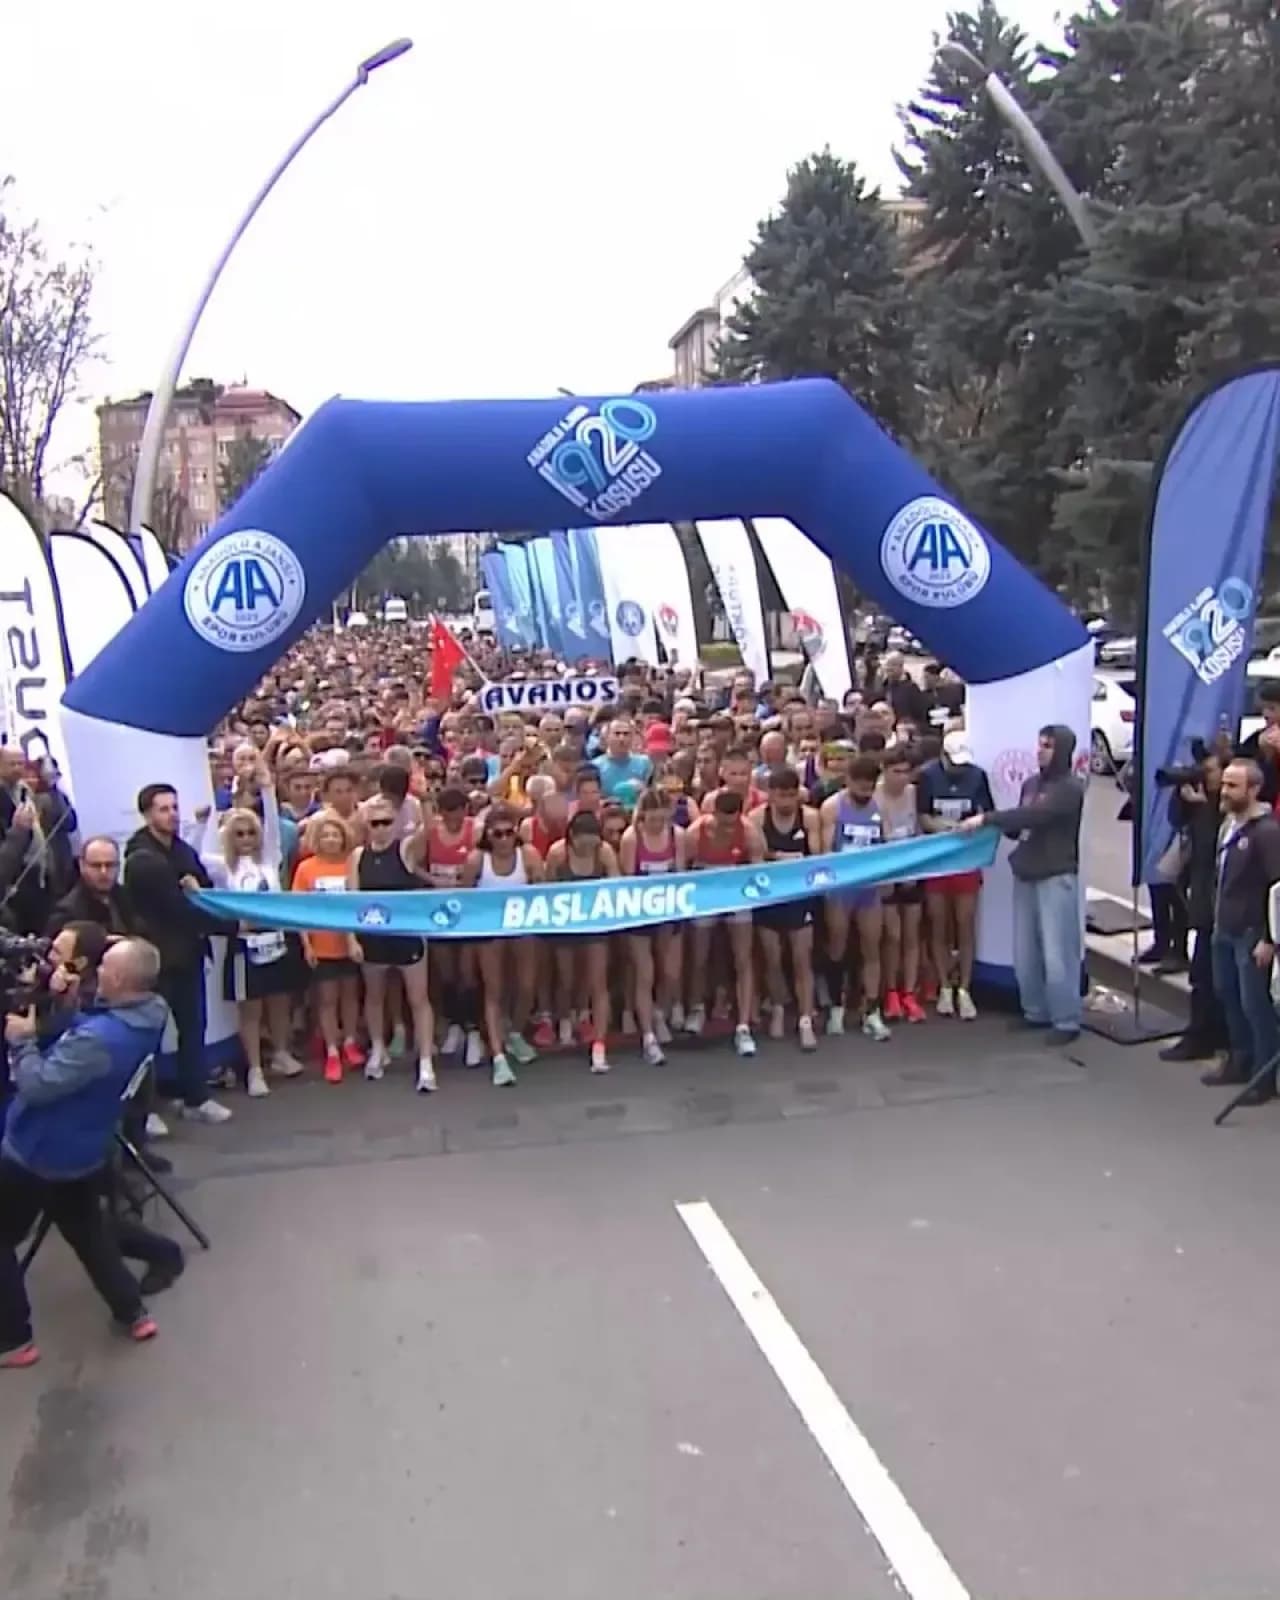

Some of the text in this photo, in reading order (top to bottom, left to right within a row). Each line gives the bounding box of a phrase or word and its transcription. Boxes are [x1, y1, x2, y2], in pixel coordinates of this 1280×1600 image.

[538, 398, 657, 508] 1920
[907, 524, 971, 571] AA
[210, 560, 281, 612] AA
[485, 679, 616, 710] AVANOS
